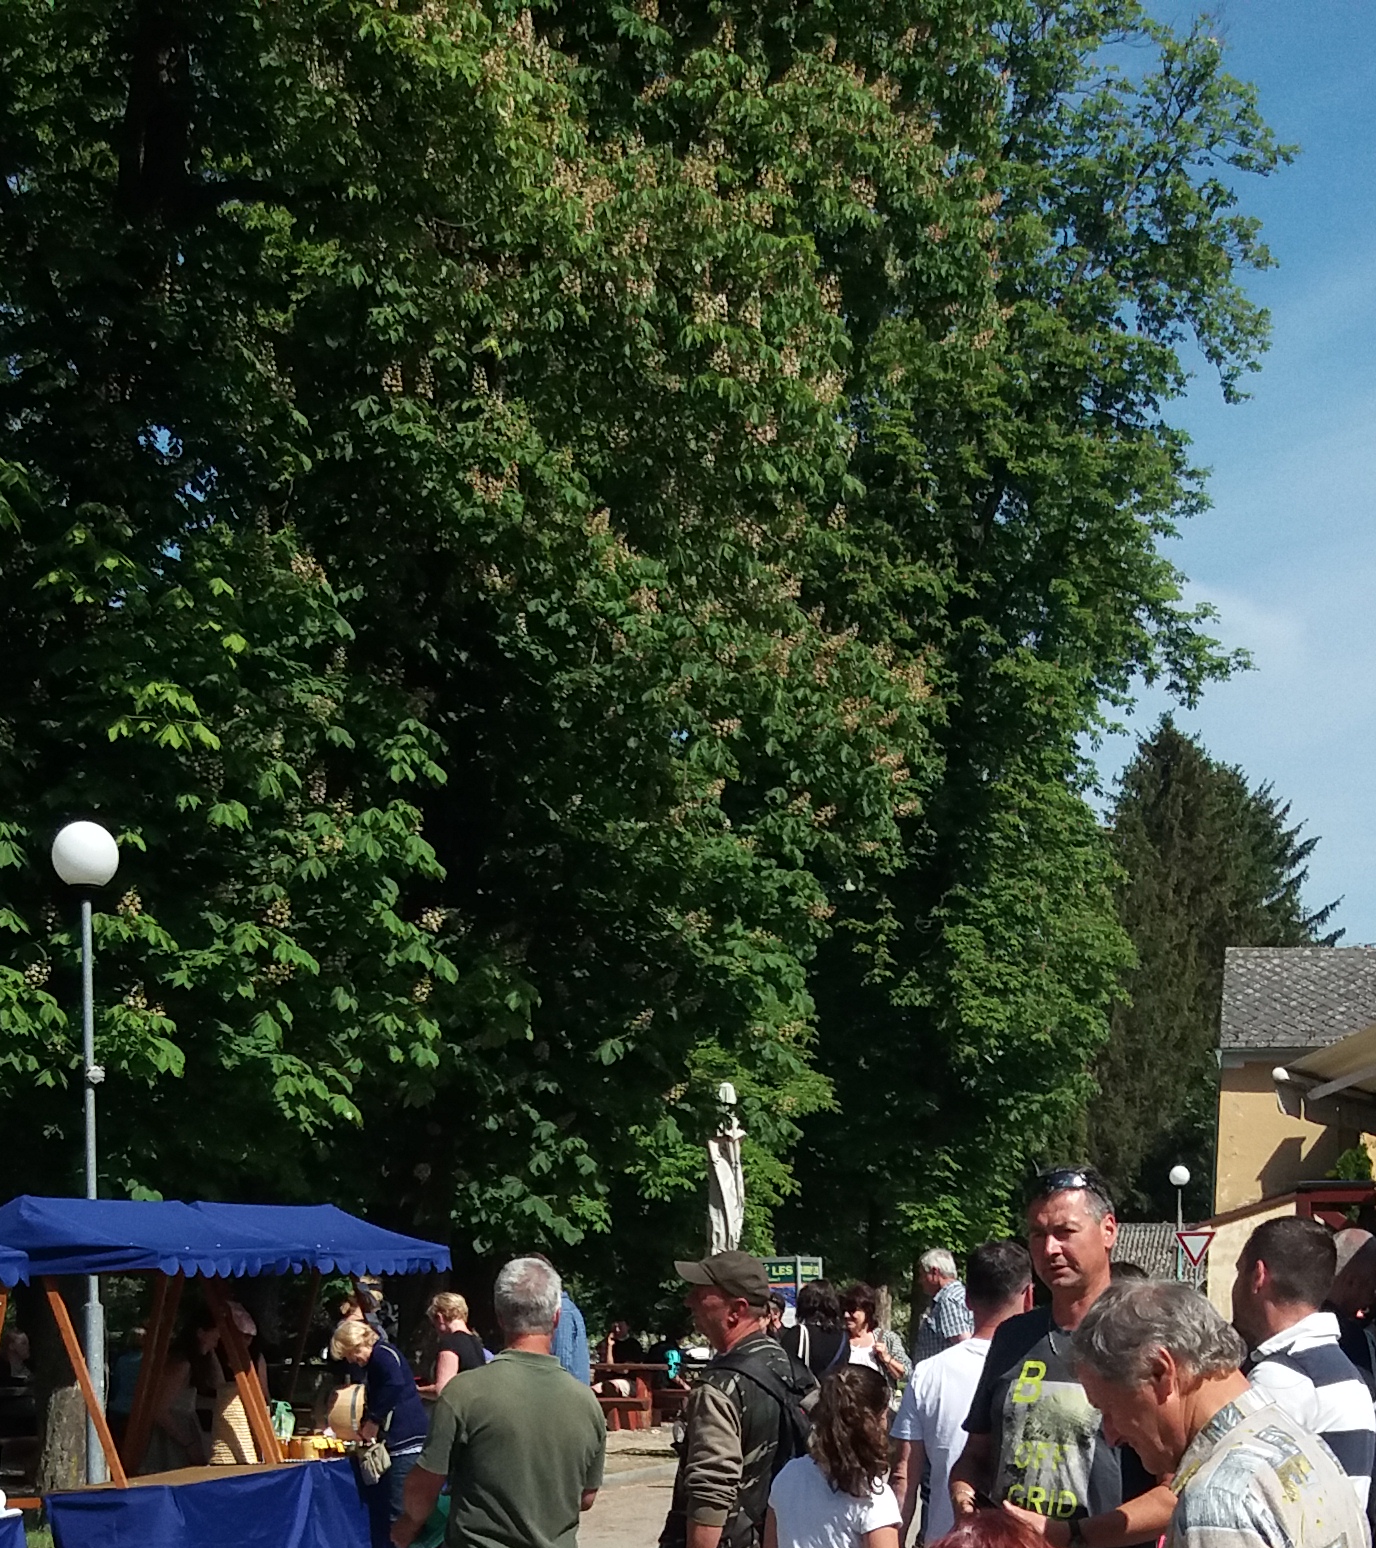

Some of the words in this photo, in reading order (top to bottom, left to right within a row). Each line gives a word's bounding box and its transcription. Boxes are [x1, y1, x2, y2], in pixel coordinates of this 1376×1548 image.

[771, 1264, 794, 1276] LES
[1014, 1441, 1070, 1471] OFF
[1007, 1483, 1078, 1518] GRID
